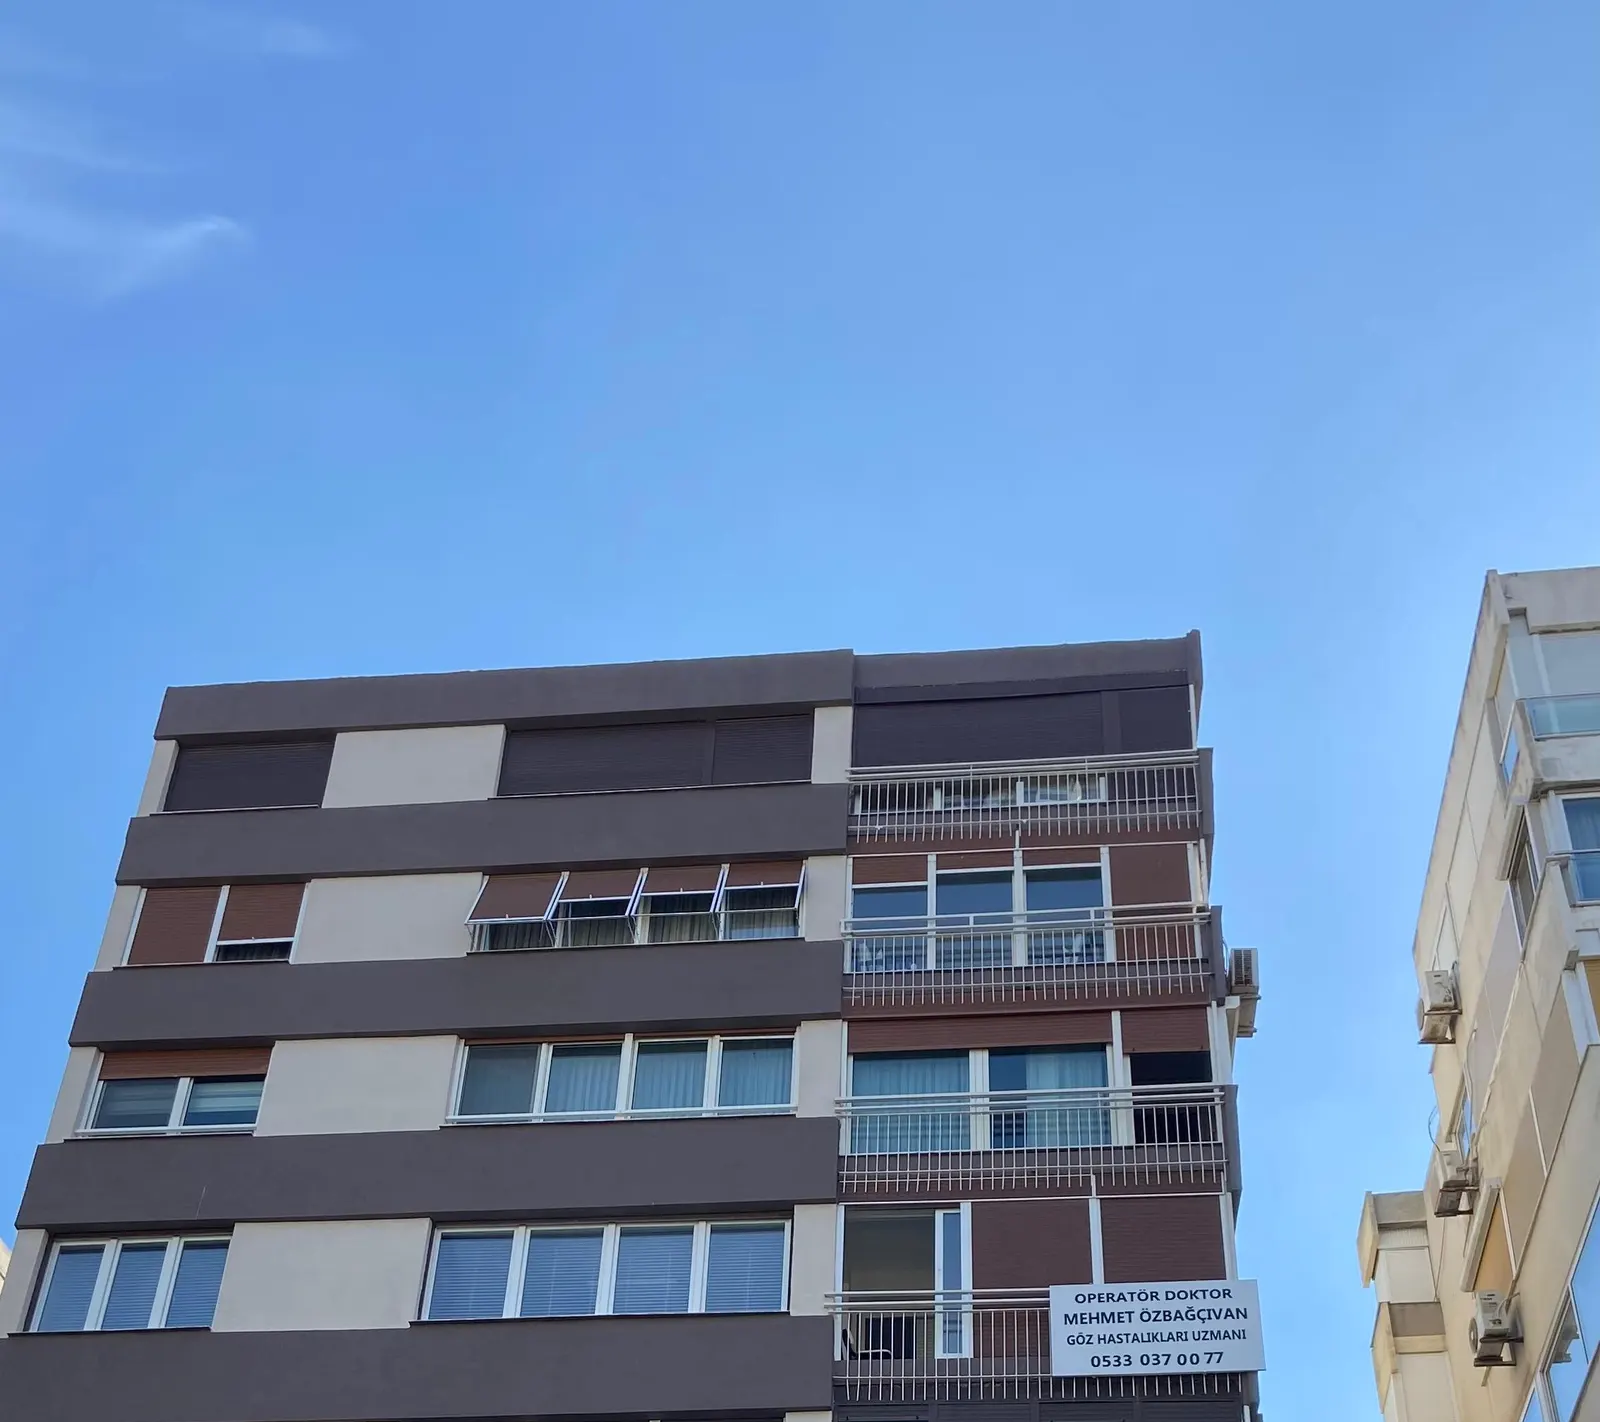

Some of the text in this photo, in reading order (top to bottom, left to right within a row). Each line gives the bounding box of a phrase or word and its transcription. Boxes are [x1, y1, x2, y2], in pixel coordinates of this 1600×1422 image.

[1074, 1288, 1233, 1304] OPERATÖR DOKTOR
[1063, 1305, 1248, 1326] MEHMET ÖZBAĞÇIVAN
[1066, 1328, 1247, 1346] GÖZ HASTALIKLARI UZMANI
[1090, 1351, 1224, 1368] 0533 037 00 77
